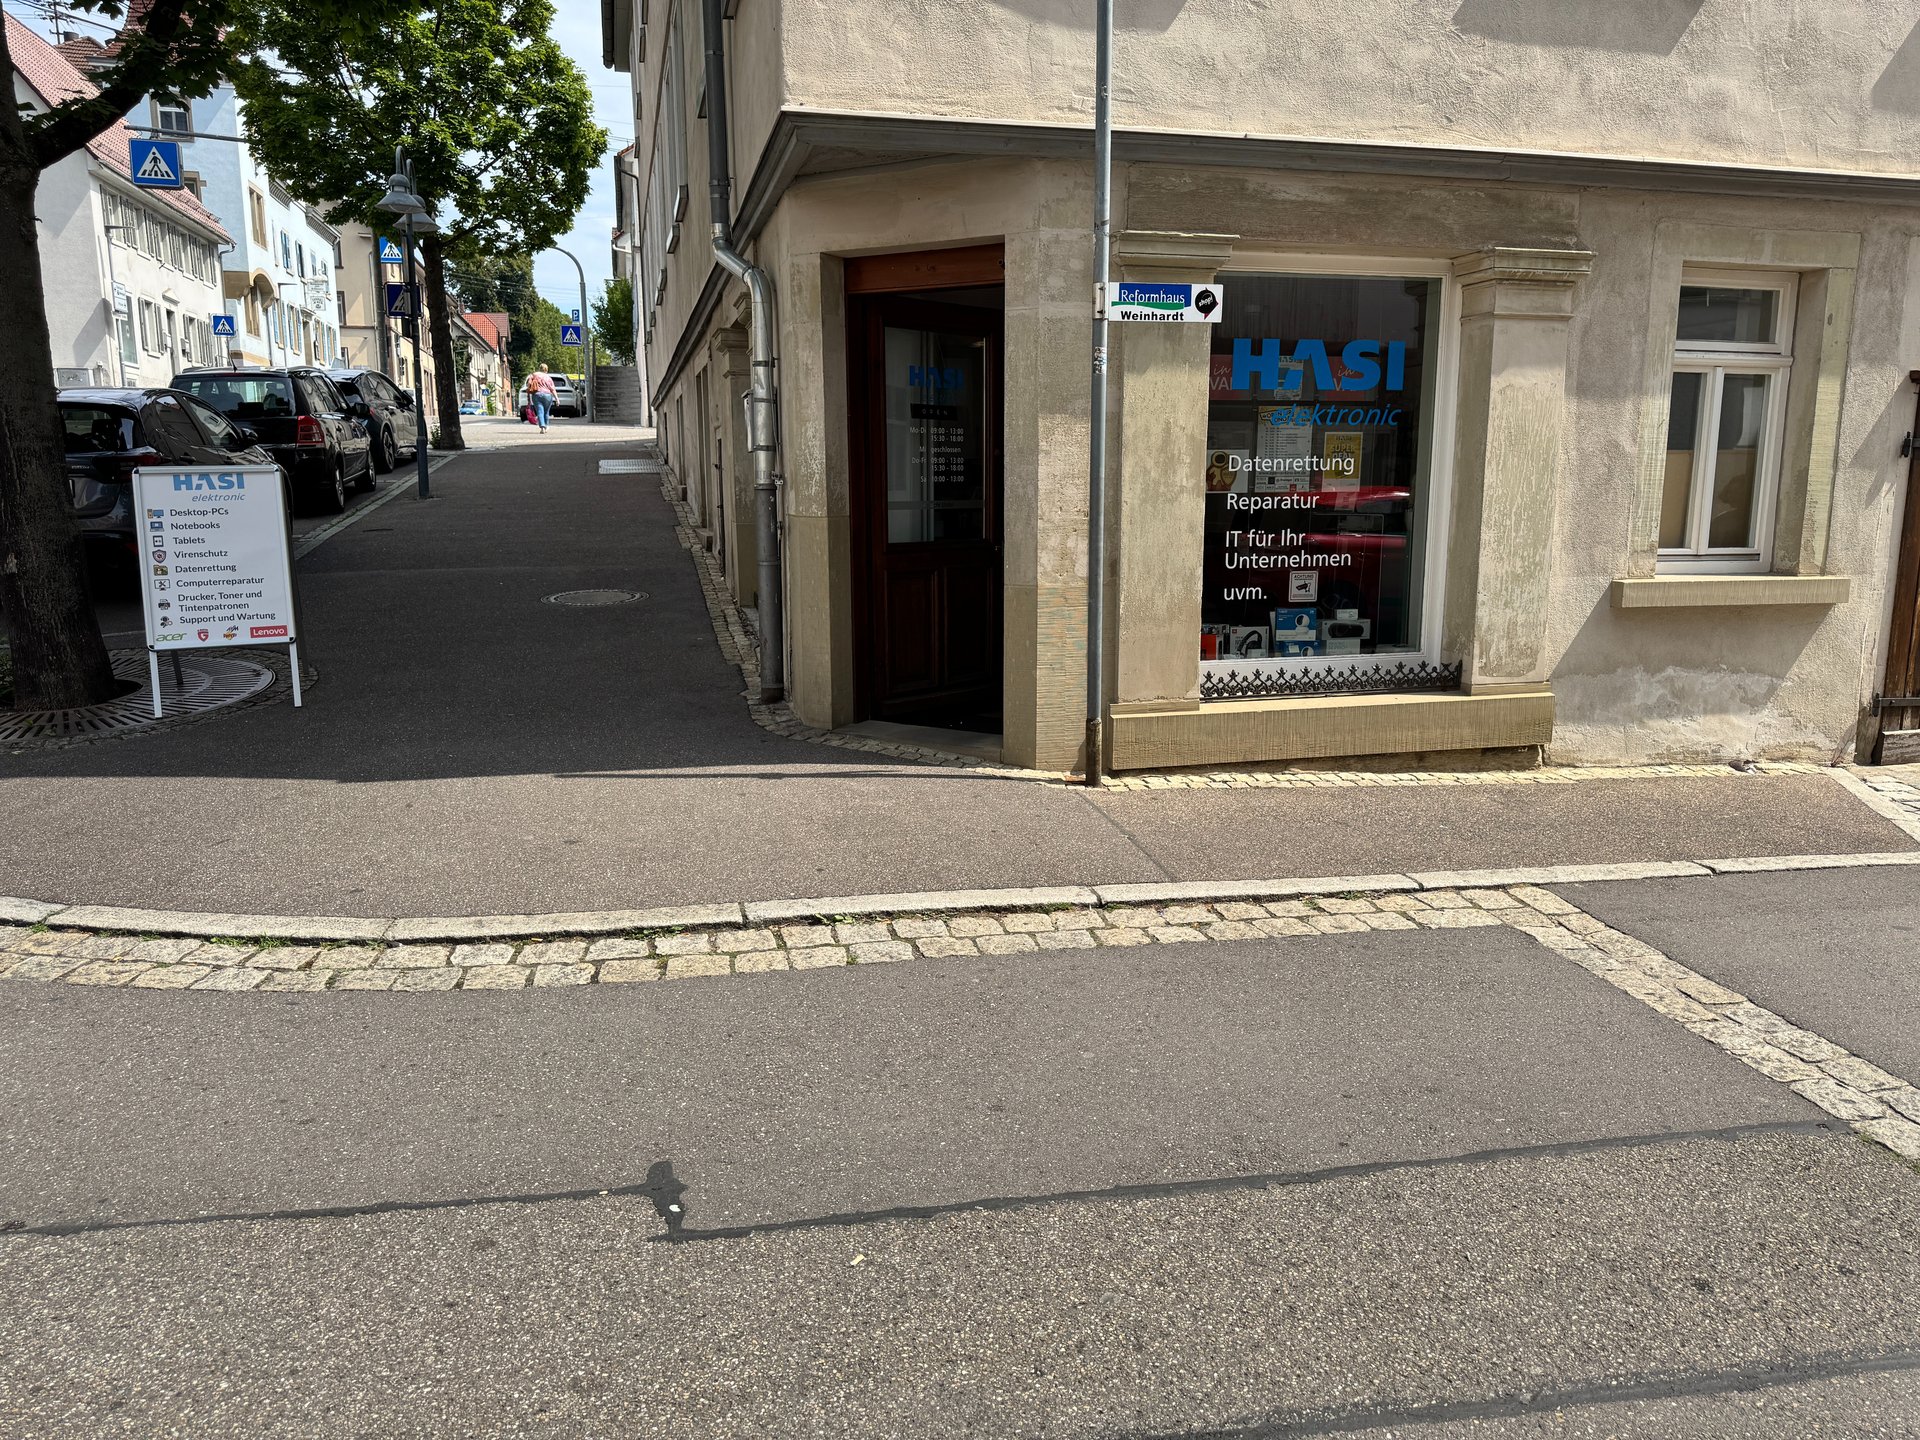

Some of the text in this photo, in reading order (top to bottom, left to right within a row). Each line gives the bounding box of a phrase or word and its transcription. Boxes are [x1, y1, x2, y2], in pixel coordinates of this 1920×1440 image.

[1121, 289, 1185, 306] Reformhaus
[1121, 311, 1185, 321] Weinhardt
[1231, 338, 1406, 391] HASI
[908, 365, 965, 389] HASI
[1271, 404, 1402, 427] elektronic
[930, 446, 962, 454] geschlossen
[1228, 455, 1355, 475] Datenrettung
[172, 472, 246, 491] HASI
[191, 493, 246, 502] elektronic
[1226, 493, 1320, 514] Reparatur
[169, 507, 229, 518] Desktop-PCs
[170, 521, 221, 531] Notebooks
[173, 536, 206, 545] Tablets
[1225, 528, 1306, 548] IT für Ihr
[173, 550, 229, 559] Virenschutz
[1225, 550, 1351, 570] Unternehmen
[175, 563, 237, 574] Datenrettung
[176, 576, 265, 589] Computerreparatur
[178, 590, 262, 603] Drucker, Toner und
[1223, 585, 1268, 601] uvm.
[178, 602, 250, 613] Tintenpatronen
[179, 611, 276, 625] Support und Wartung
[155, 632, 188, 642] acer
[252, 627, 285, 636] Lenovo
